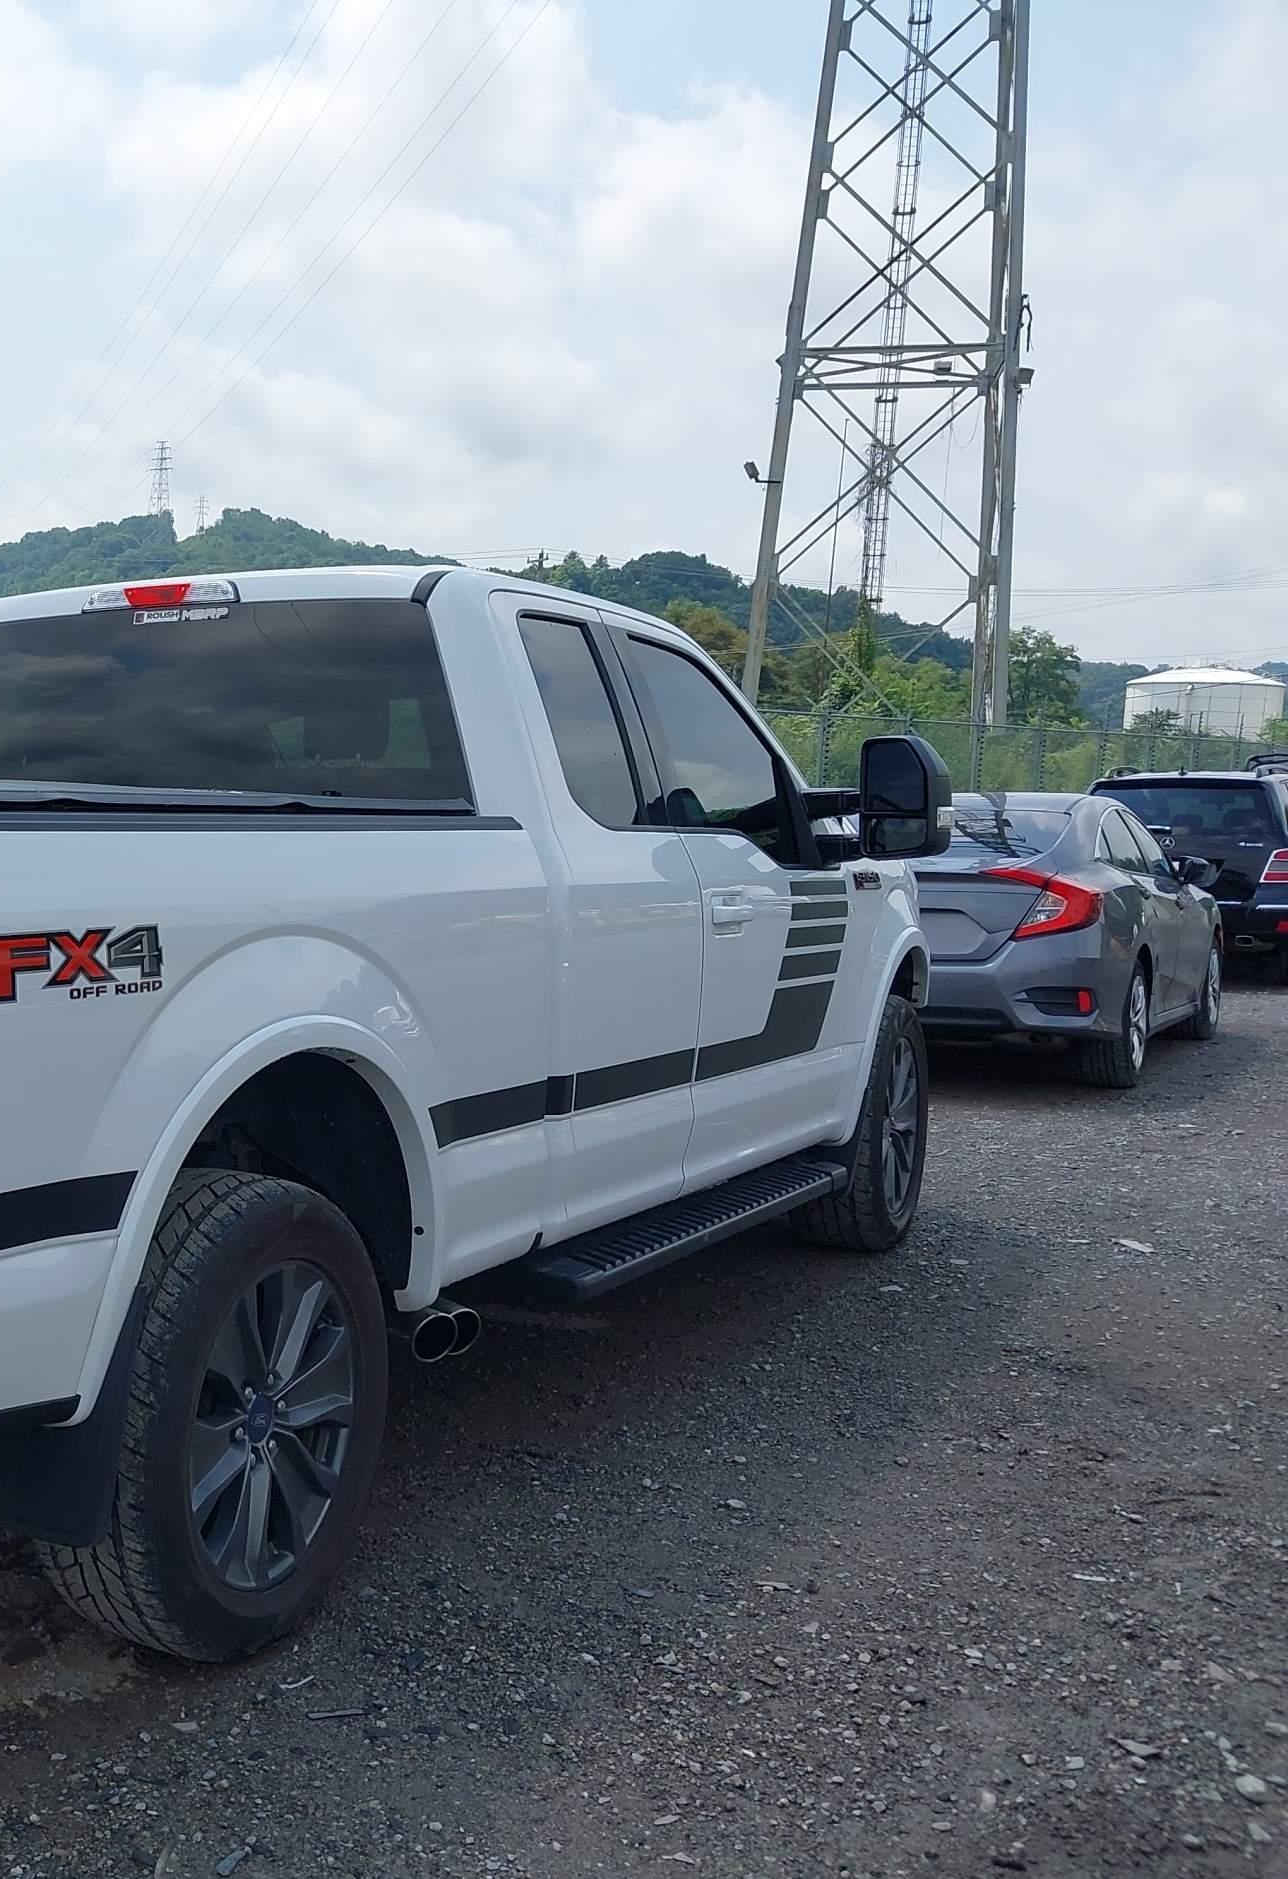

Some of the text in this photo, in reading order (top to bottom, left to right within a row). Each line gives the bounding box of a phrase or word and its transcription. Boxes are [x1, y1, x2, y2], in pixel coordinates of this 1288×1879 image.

[146, 611, 180, 620] ROUSH
[69, 980, 163, 1000] OFF ROAD
